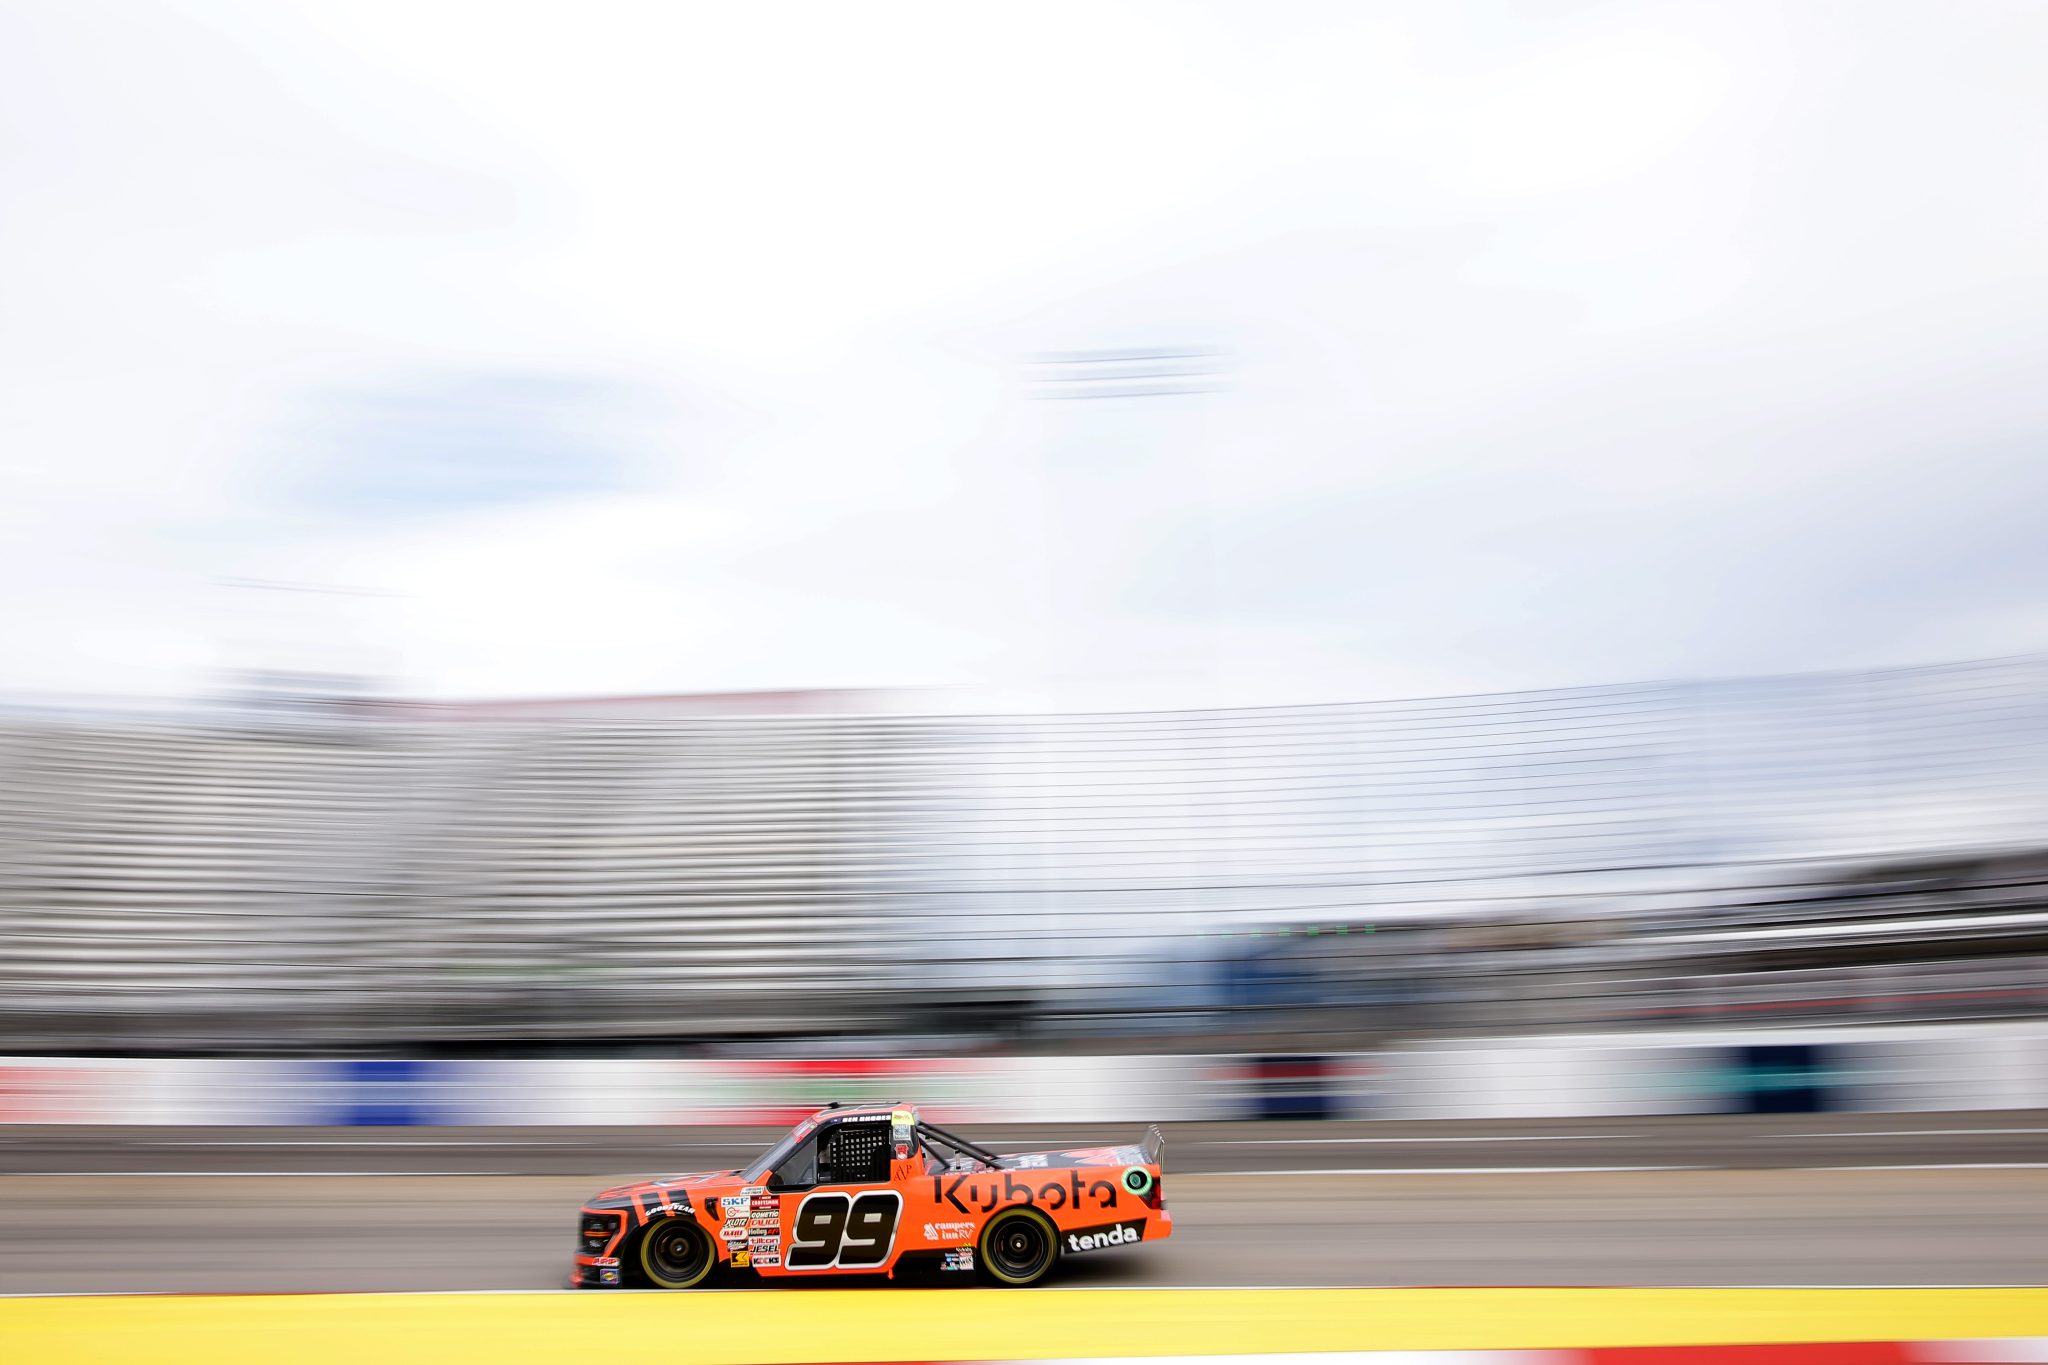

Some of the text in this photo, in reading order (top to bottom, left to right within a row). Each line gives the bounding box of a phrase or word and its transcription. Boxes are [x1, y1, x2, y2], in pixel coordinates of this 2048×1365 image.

[934, 1169, 1117, 1214] Kubota
[645, 1203, 695, 1216] GOODYEAR
[725, 1218, 747, 1226] KLOTZ
[785, 1190, 904, 1270] 99
[935, 1222, 976, 1231] campers
[1068, 1223, 1138, 1252] tenda
